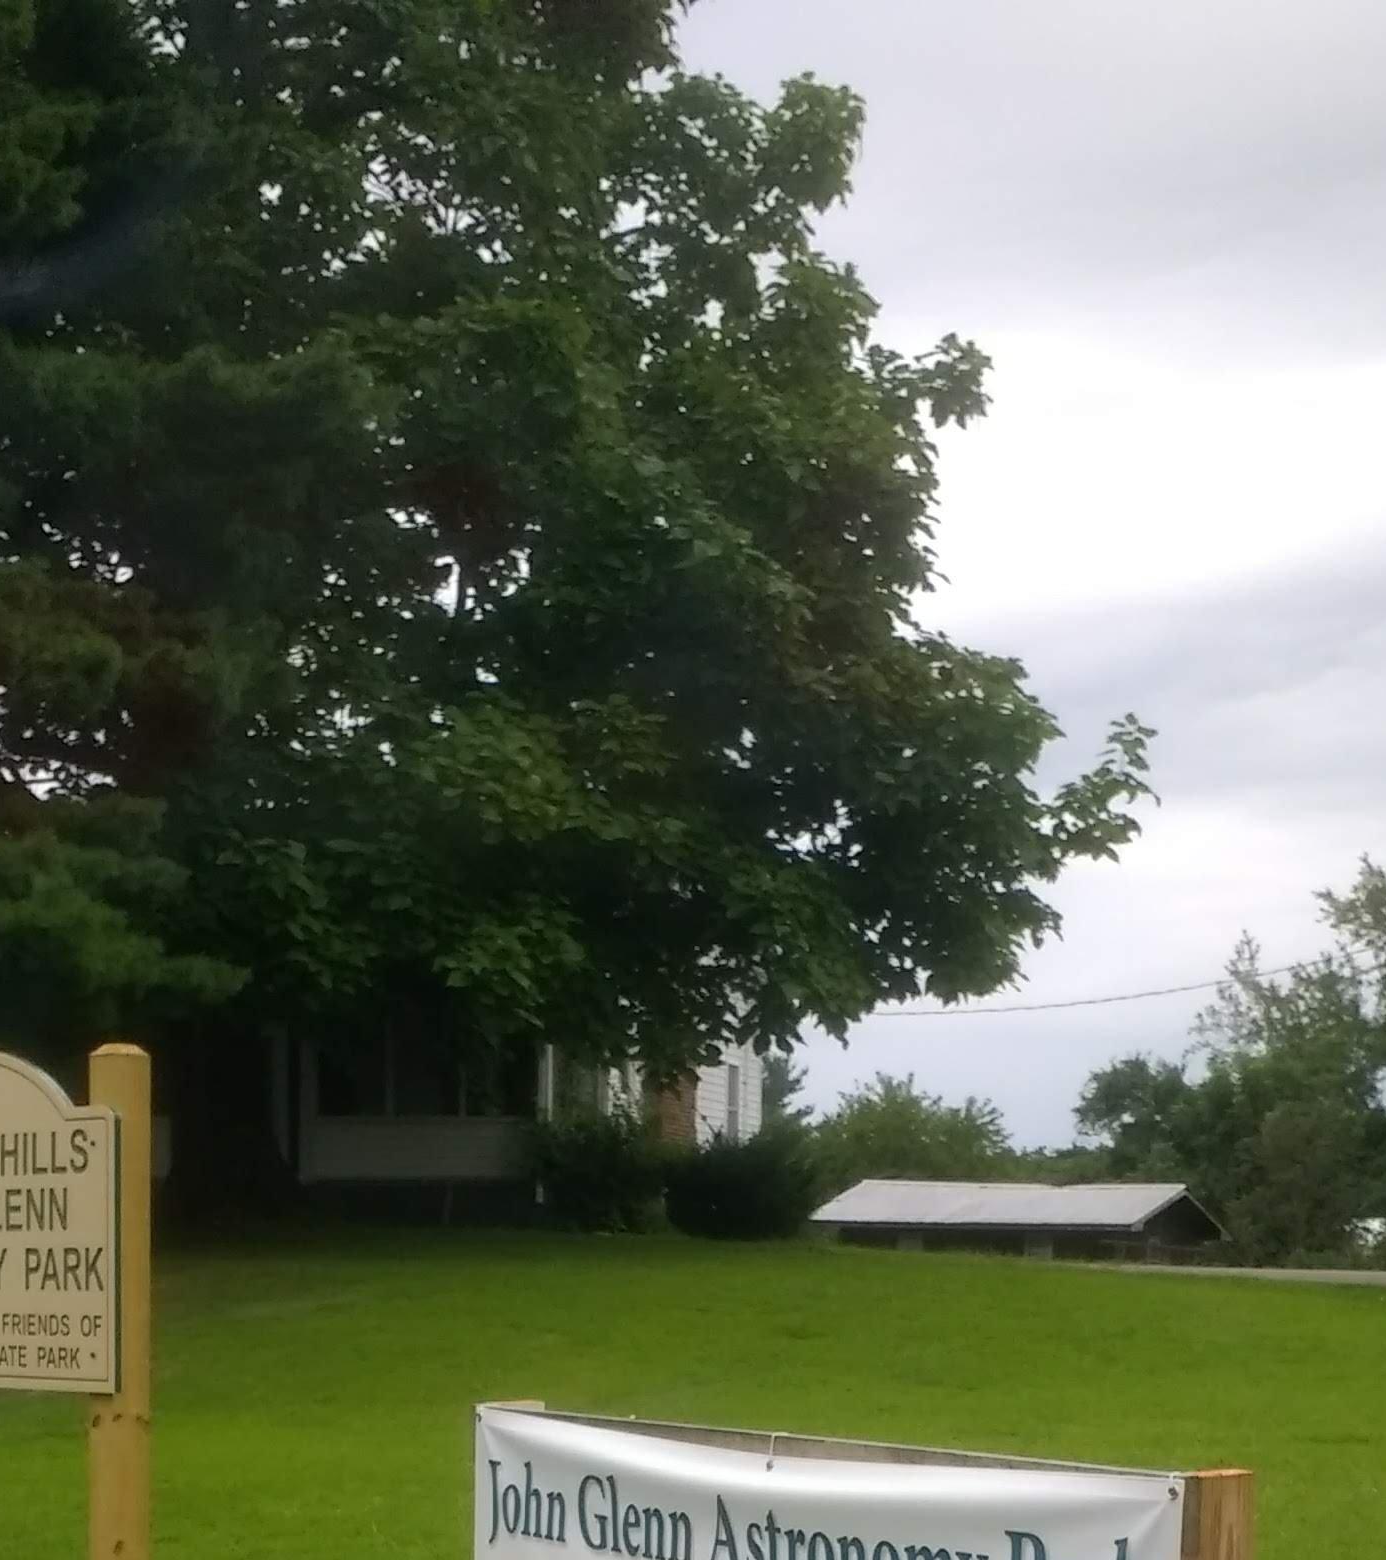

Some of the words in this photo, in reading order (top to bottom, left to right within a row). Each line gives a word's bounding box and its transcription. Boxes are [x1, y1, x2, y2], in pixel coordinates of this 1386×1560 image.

[0, 1129, 89, 1176] HILLS
[25, 1247, 104, 1292] PARK
[2, 1313, 70, 1337] FRIENDS
[80, 1315, 102, 1338] OF
[37, 1347, 81, 1370] PARK
[488, 1459, 566, 1544] John
